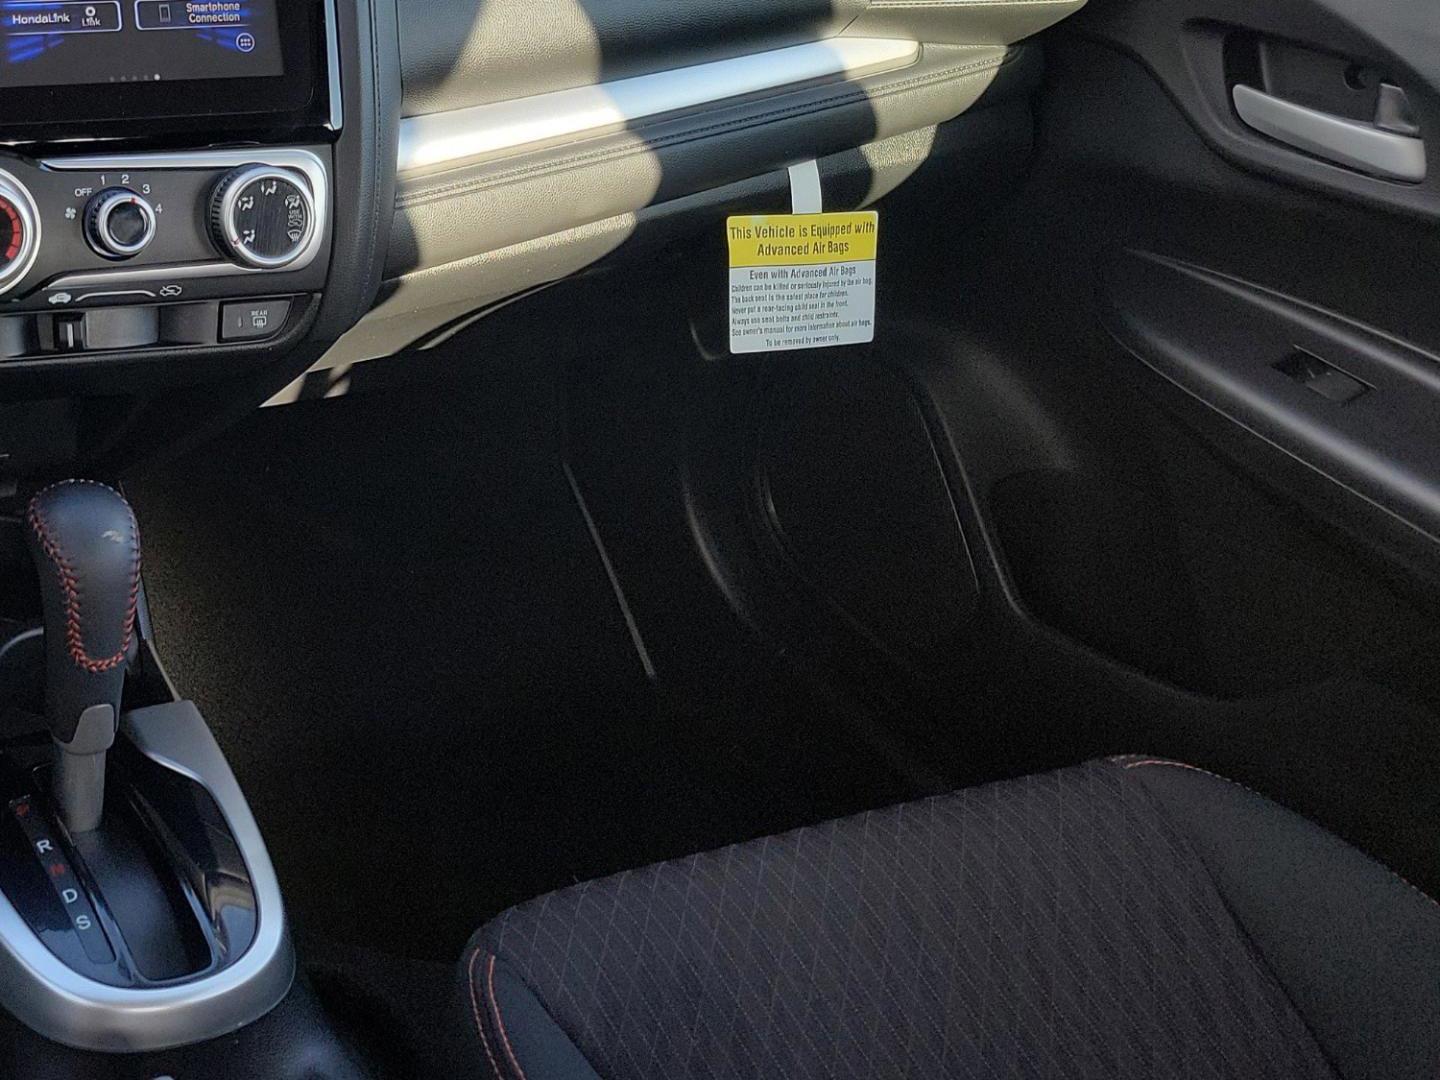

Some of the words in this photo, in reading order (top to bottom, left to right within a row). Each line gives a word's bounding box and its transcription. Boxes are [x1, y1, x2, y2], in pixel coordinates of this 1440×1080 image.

[185, 1, 241, 14] Smartphone
[188, 11, 241, 24] Connection
[121, 174, 130, 185] 2
[74, 187, 93, 198] OFF
[142, 184, 151, 194] 3
[729, 226, 752, 240] This
[754, 225, 795, 239] Vehicle
[799, 225, 808, 237] is
[810, 222, 852, 239] Equipped
[854, 220, 875, 234] with
[757, 242, 809, 256] Advanced
[812, 241, 825, 254] Air
[827, 240, 849, 255] Bags
[749, 269, 769, 280] Even
[770, 268, 789, 279] with
[790, 267, 828, 278] Advanced
[829, 266, 839, 277] Air
[840, 265, 857, 277] Bags
[36, 839, 54, 854] R
[62, 889, 78, 904] D
[76, 914, 91, 930] S
